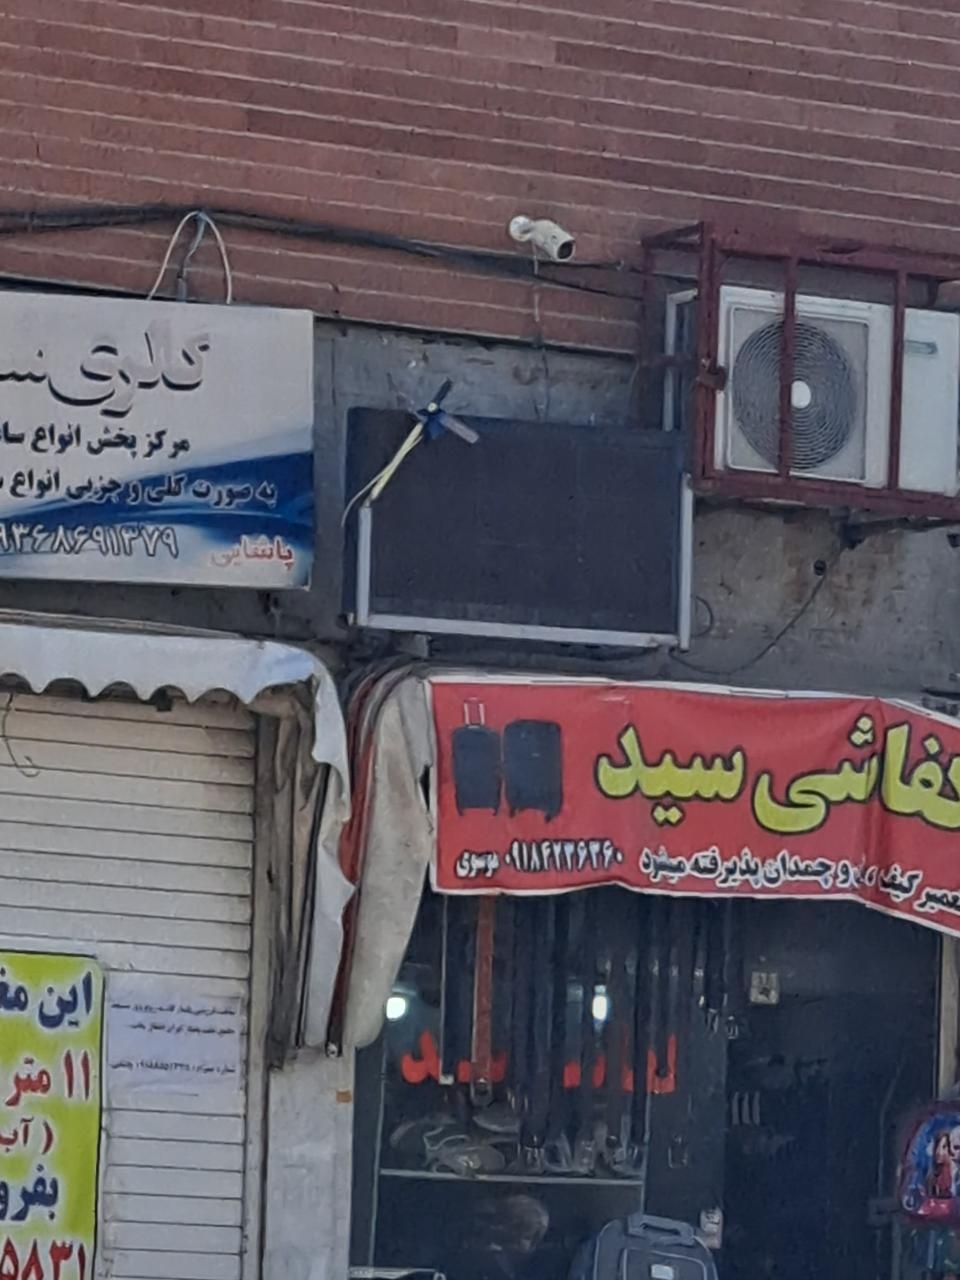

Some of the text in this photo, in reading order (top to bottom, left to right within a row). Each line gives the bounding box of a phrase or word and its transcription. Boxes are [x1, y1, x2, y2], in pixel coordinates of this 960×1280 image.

[0, 420, 191, 459] مرکز پخش انواع سا
[9, 468, 60, 499] انواع
[127, 483, 142, 504] و
[146, 474, 186, 504] کلی
[192, 479, 252, 508] صورت
[255, 480, 279, 509] به
[595, 722, 746, 826] سید
[456, 851, 500, 878] موسوی
[689, 846, 762, 888] پذیرفته
[763, 850, 833, 888] چمدان
[837, 860, 852, 888] و
[881, 865, 921, 901] کیف
[0, 967, 92, 1028] این مغ
[64, 1050, 90, 1101] ۱۱
[0, 1164, 58, 1222] بفرو
